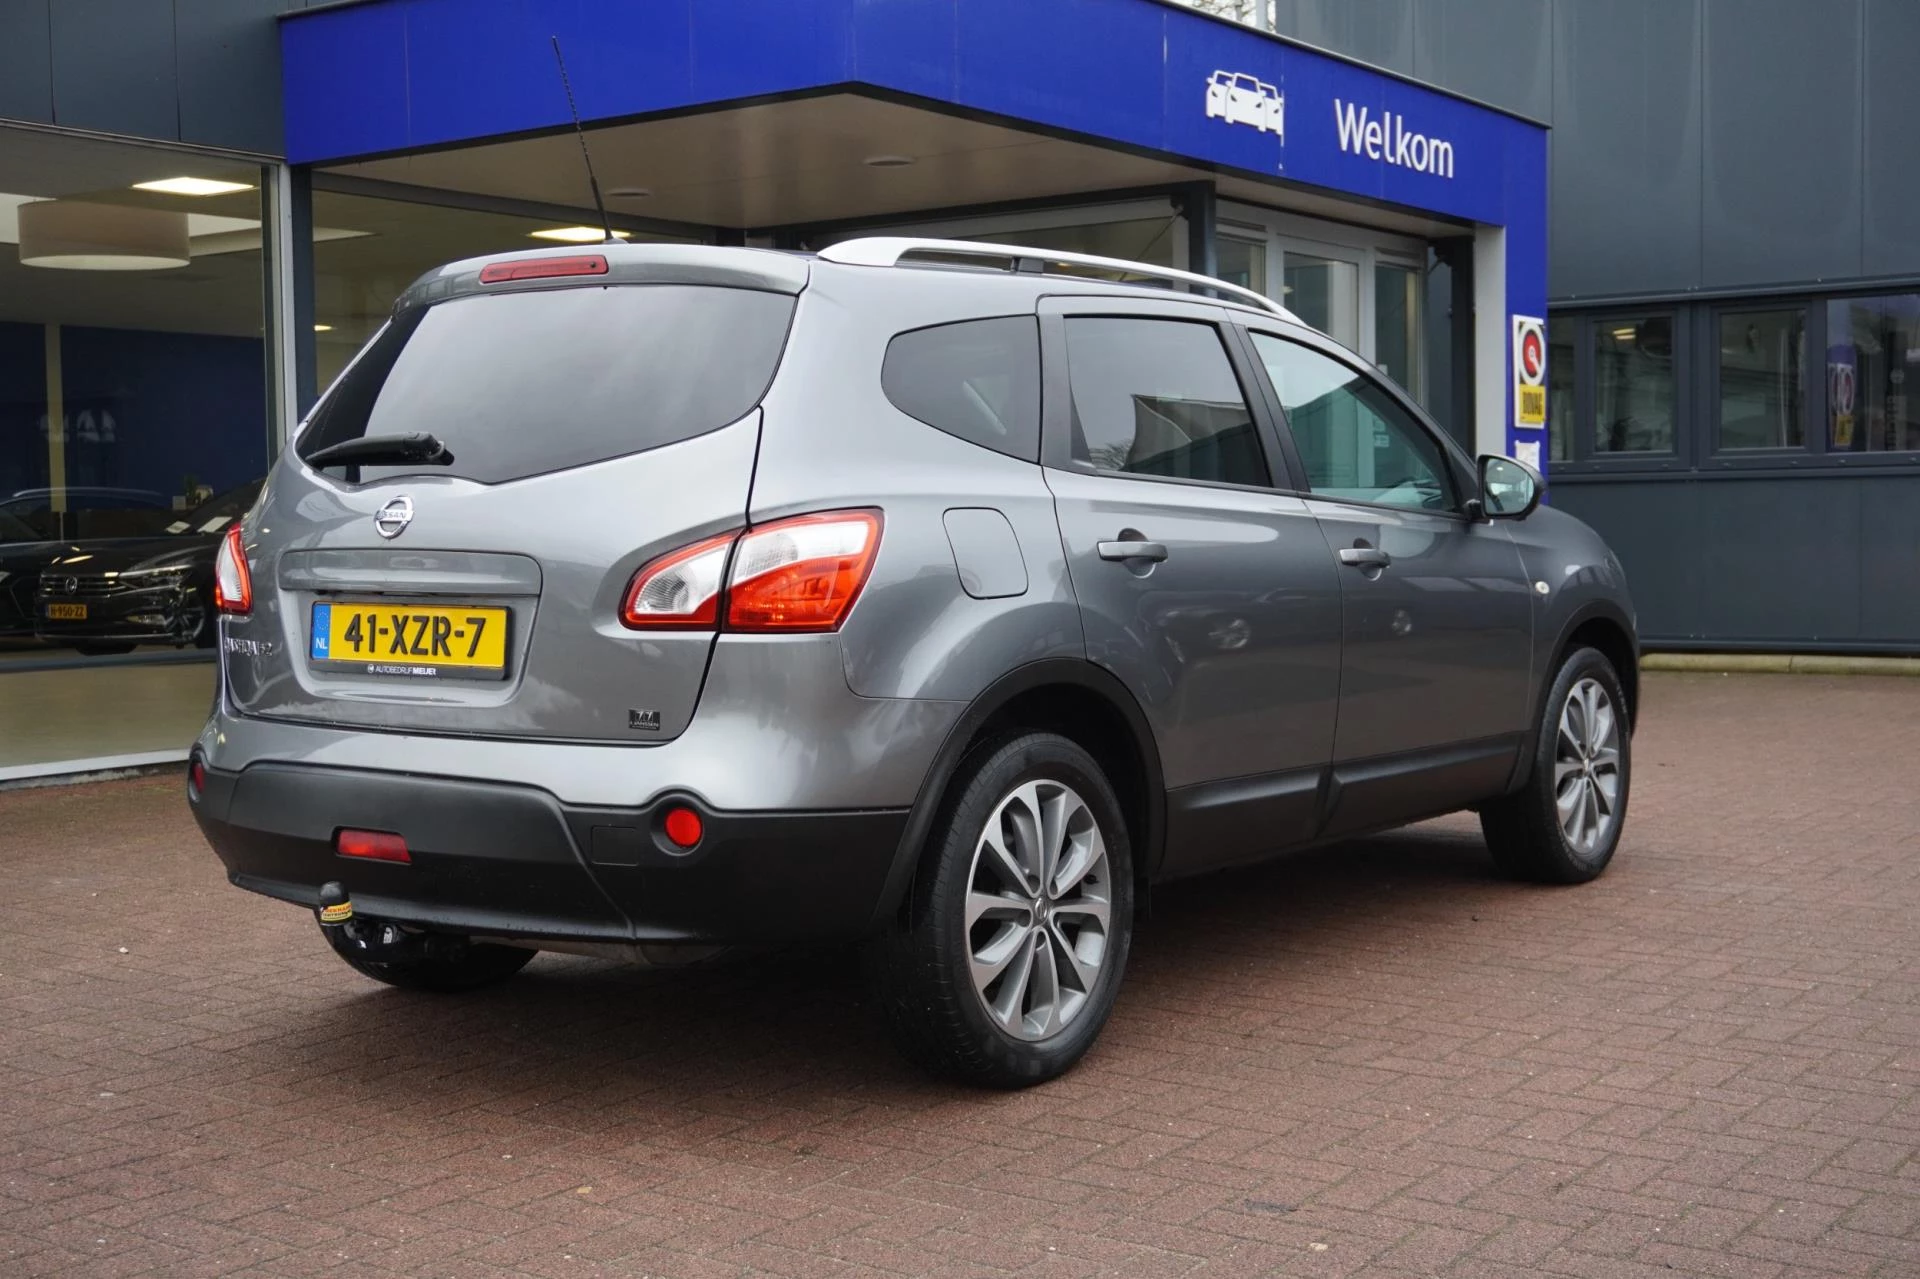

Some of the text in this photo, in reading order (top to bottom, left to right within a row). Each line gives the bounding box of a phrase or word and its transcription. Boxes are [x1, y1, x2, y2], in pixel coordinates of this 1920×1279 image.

[1334, 98, 1453, 179] Welkom
[315, 637, 328, 650] NL
[343, 613, 487, 658] 41-XZR-7
